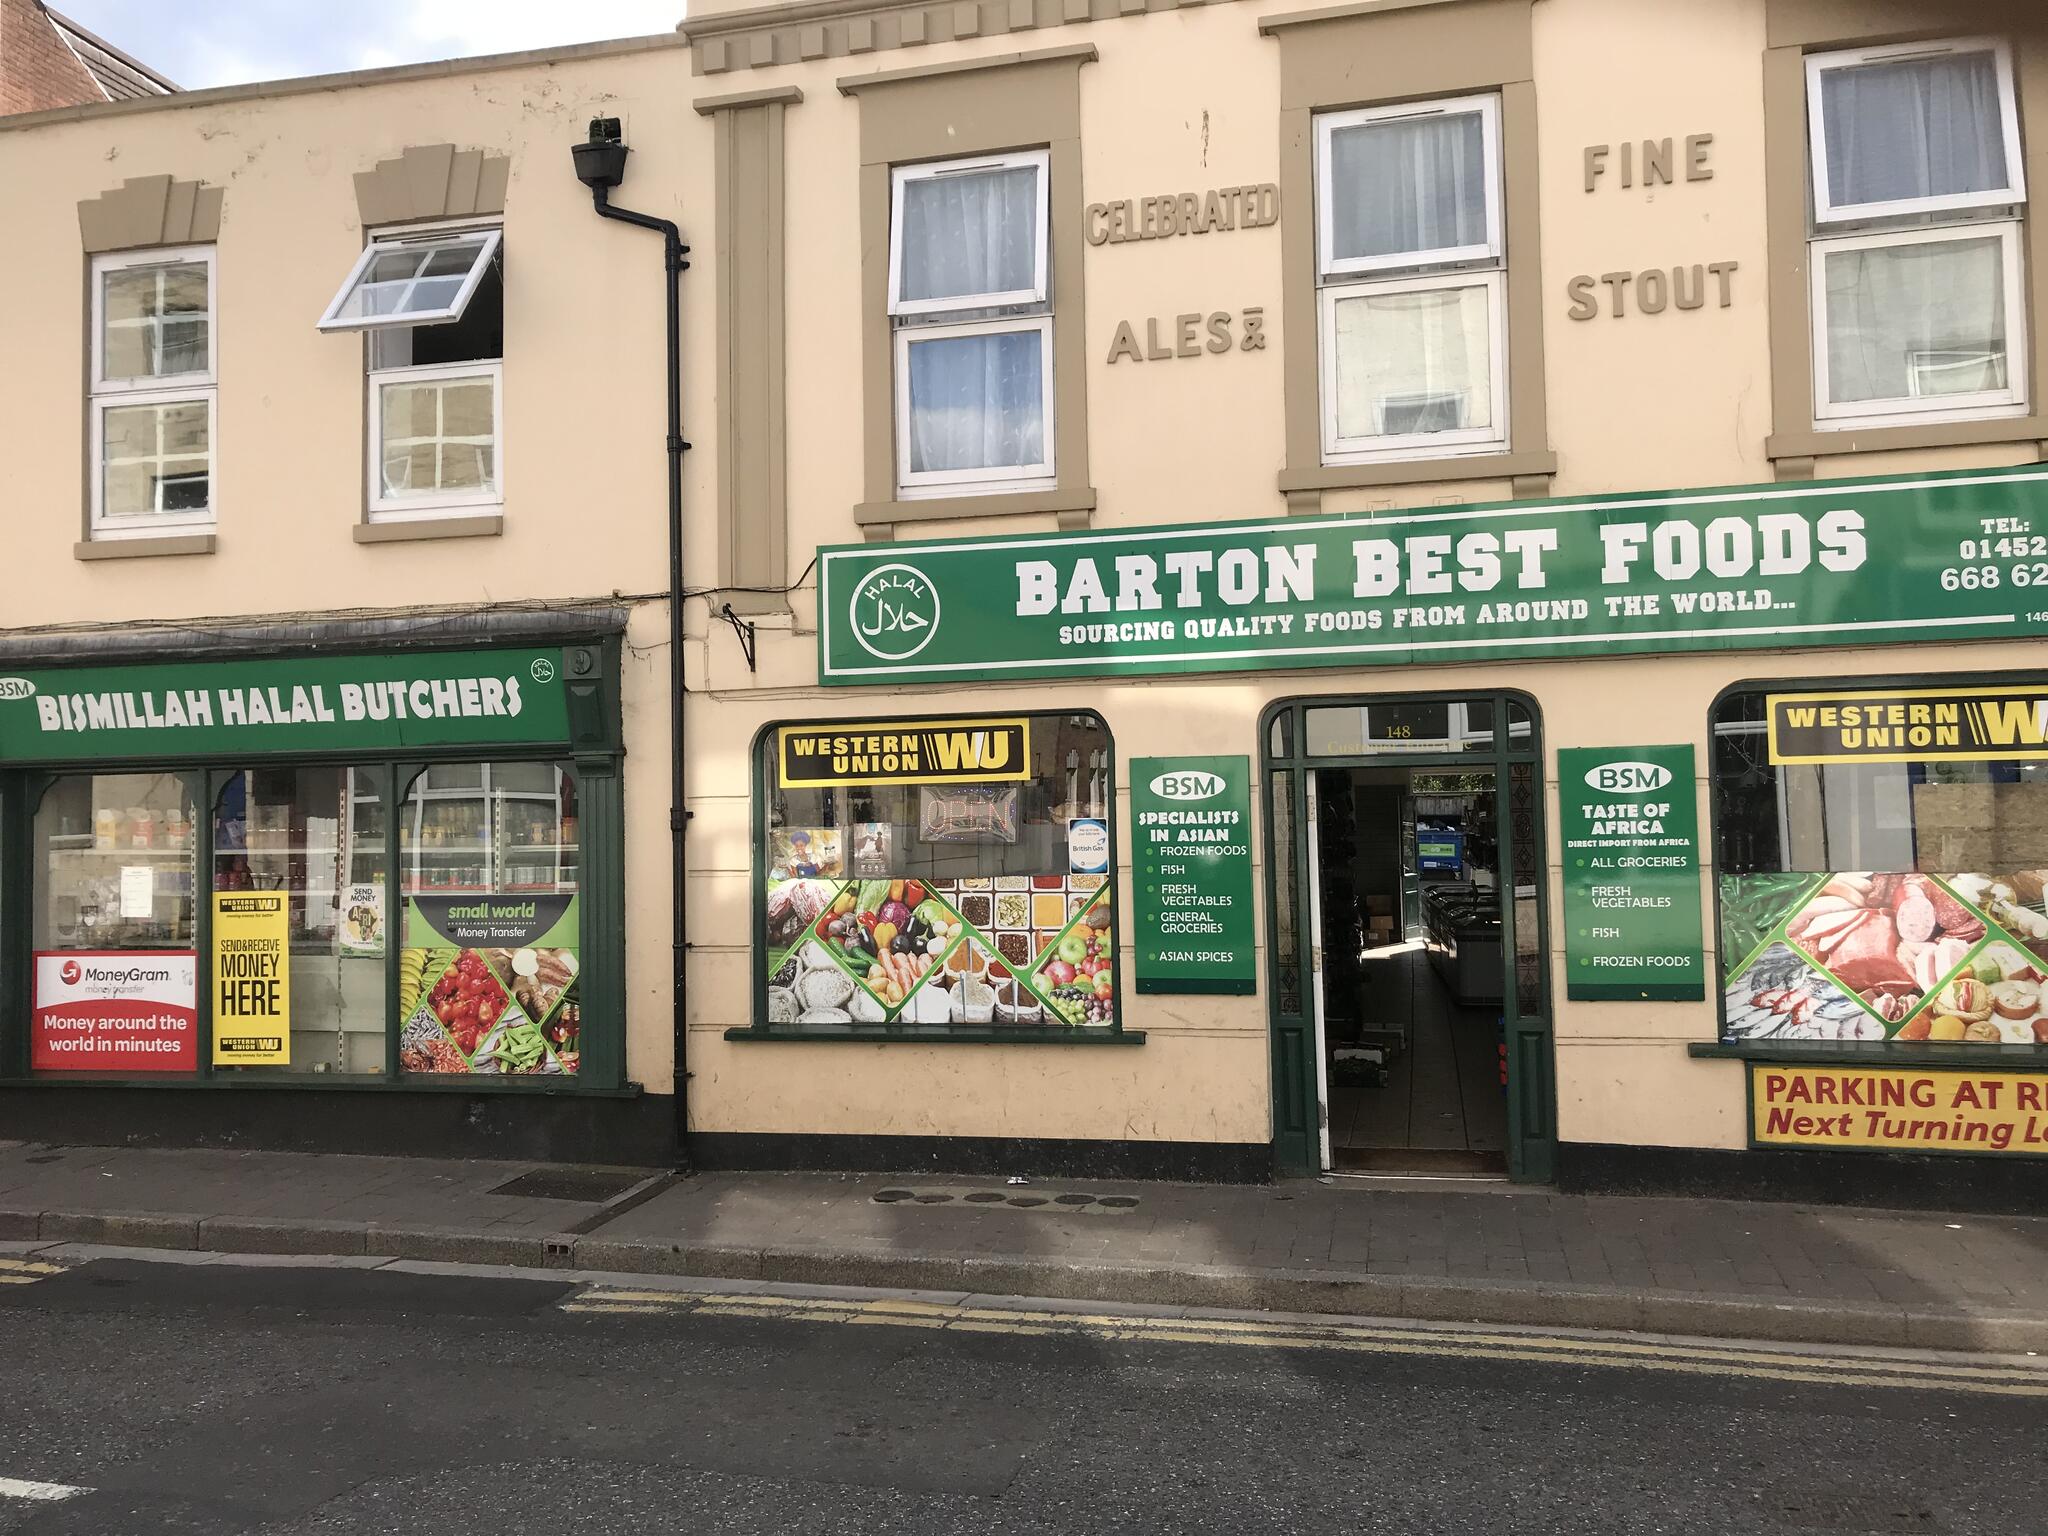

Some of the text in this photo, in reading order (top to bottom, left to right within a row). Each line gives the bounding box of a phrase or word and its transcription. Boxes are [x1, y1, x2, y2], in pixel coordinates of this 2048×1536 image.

[1583, 133, 1714, 193] FINE
[1085, 182, 1280, 246] CELEBRATED
[1567, 261, 1738, 320] STOUT
[1980, 517, 2030, 534] TEL:
[1960, 536, 2047, 559] 01452
[1015, 509, 1867, 616] BARTON BEST FOODS
[1941, 563, 2048, 591] 668 62
[864, 575, 925, 600] HALAL
[1059, 589, 1797, 644] SOURCING QUALITY FOODS FROM AROUND THE WORLD...
[36, 689, 214, 732] BISMILLAH
[220, 684, 335, 726] HALAL
[341, 675, 522, 722] BUTCHERS
[1786, 704, 1958, 728] WESTERN
[1386, 725, 1411, 739] 148
[1841, 726, 1959, 749] UNION
[793, 734, 919, 757] WESTERN
[934, 731, 1010, 770] WU
[833, 753, 919, 774] UNION
[1163, 777, 1215, 796] BSM
[1599, 768, 1660, 788] BSM
[927, 800, 1008, 830] OPEN
[1138, 810, 1239, 826] SPECIALISTS
[1582, 803, 1670, 819] TASTE OF
[1150, 828, 1229, 842] IN ASIAN
[1591, 820, 1664, 835] AFRICA
[1567, 838, 1690, 848] DIRECT IMPORT FROM AFRICA
[1161, 865, 1185, 875] FISH
[1591, 857, 1687, 868] ALL GROCERIES
[1161, 884, 1196, 894] FRESH
[1591, 887, 1631, 897] FRESH
[1162, 896, 1232, 906] VEGETABLES
[1592, 898, 1671, 908] VEGETABLES
[448, 902, 536, 919] small world
[1160, 912, 1214, 922] GENERAL
[457, 927, 526, 939] Money Transfer
[1161, 923, 1223, 933] GROCERIES
[1592, 928, 1619, 938] FISH
[221, 953, 280, 977] MONEY
[1159, 951, 1233, 962] ASIAN SPICES
[1593, 956, 1691, 967] FROZEN FOODS
[85, 968, 169, 984] MoneyGram
[221, 980, 280, 1016] HERE
[44, 1015, 187, 1033] Money around the
[49, 1037, 181, 1052] world in minutes
[1766, 1075, 2048, 1111] PARKING AT R
[1766, 1108, 1852, 1137] Next
[1864, 1110, 2014, 1149] Turning
